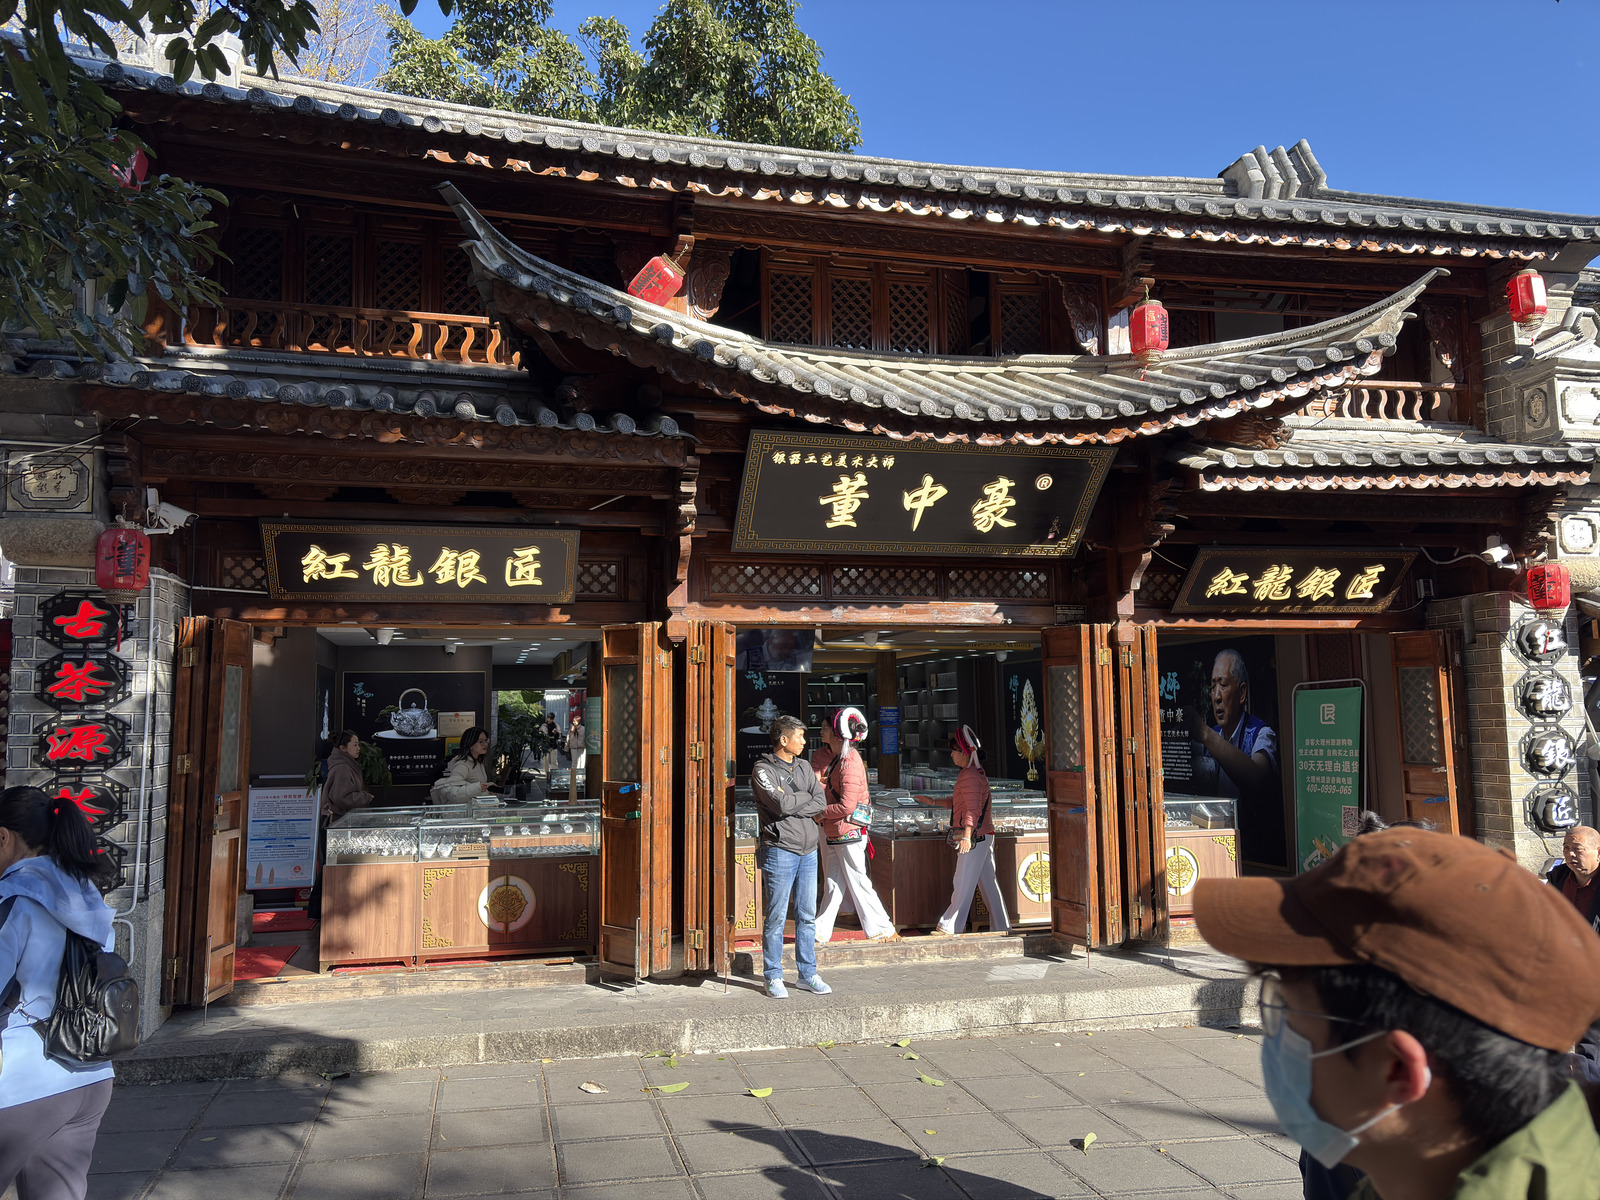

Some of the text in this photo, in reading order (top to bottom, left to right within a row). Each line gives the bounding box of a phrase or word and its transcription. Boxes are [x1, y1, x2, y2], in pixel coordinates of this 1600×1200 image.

[771, 450, 895, 470] 银器工艺美术大师
[818, 471, 1017, 533] 董中豪
[300, 542, 543, 588] 紅龍銀匠
[1205, 563, 1386, 601] 紅龍銀匠
[1298, 760, 1359, 773] 30天无理由退货
